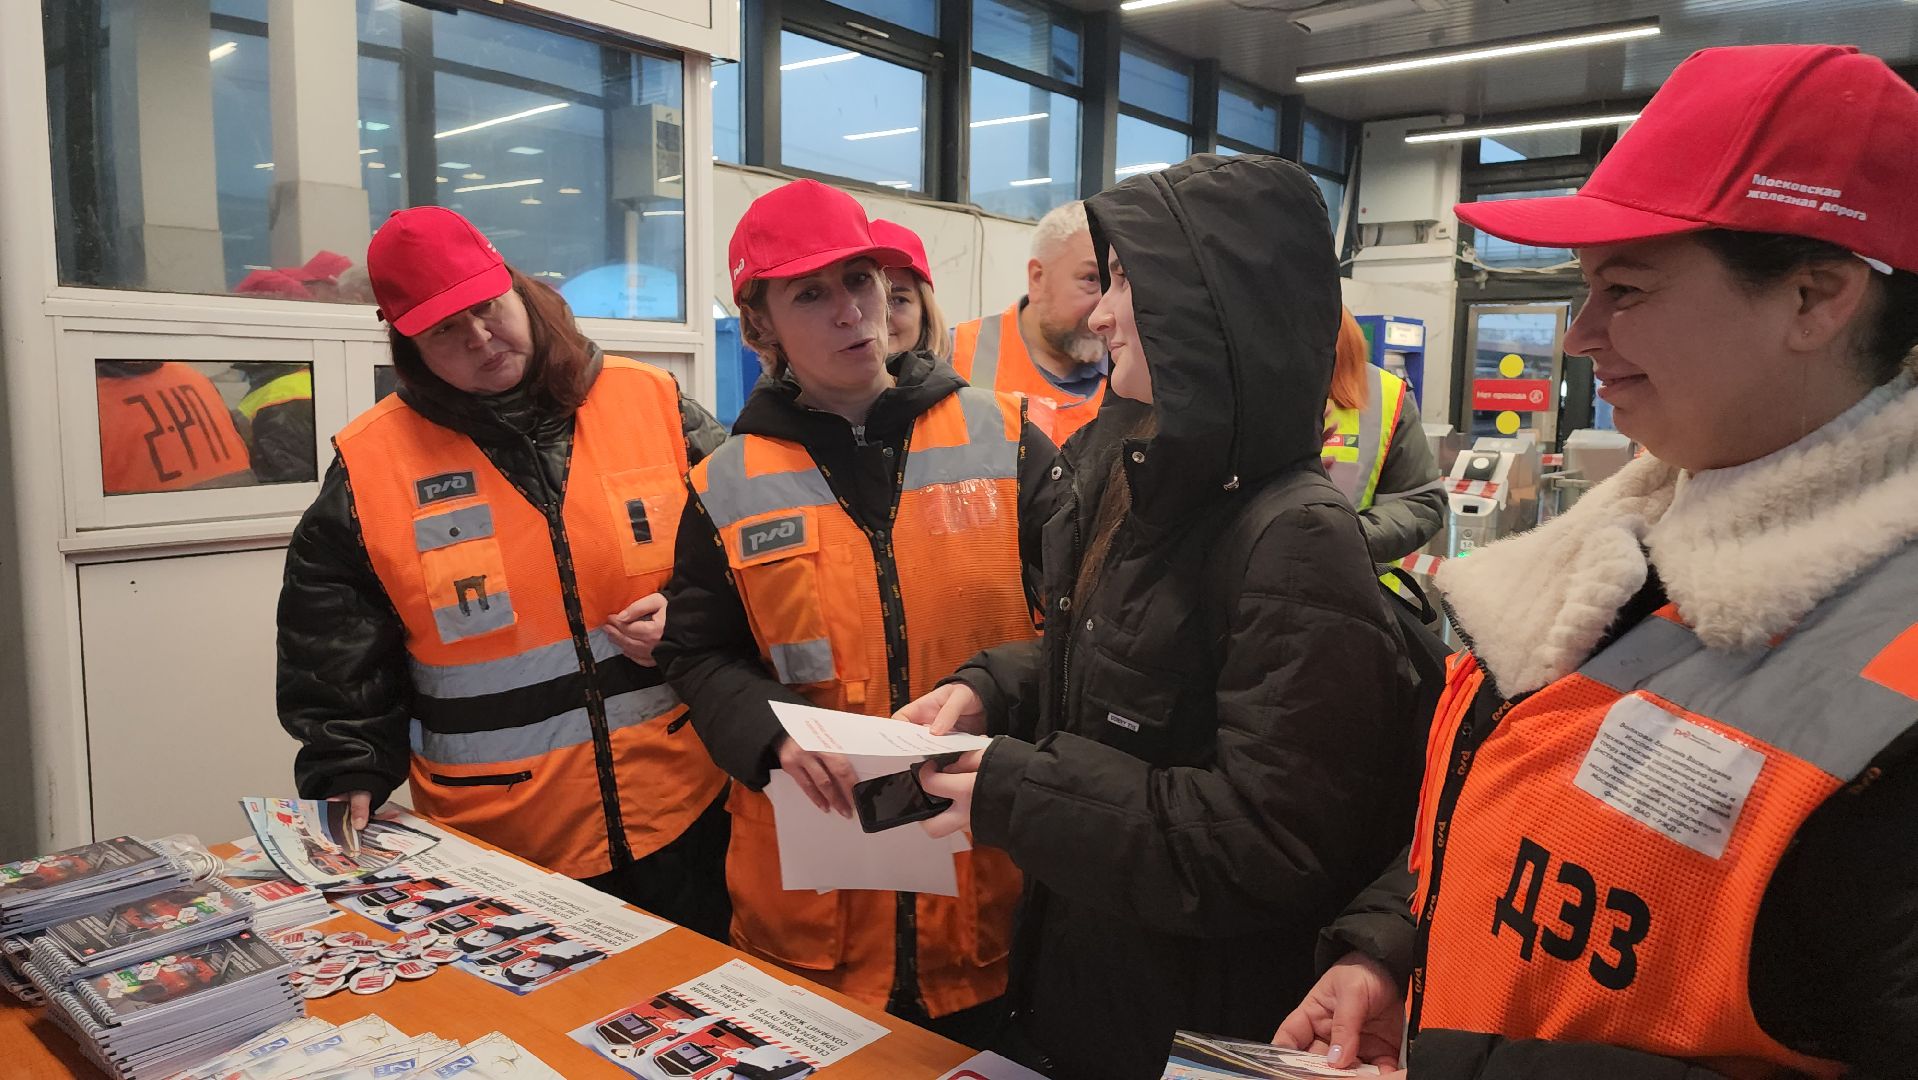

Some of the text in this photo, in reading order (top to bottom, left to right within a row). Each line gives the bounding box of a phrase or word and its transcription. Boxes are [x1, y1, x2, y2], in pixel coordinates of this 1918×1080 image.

[1752, 173, 1841, 198] Московская
[1746, 189, 1867, 221] железная дорога
[1491, 836, 1651, 991] ДЭЗ
[779, 1009, 806, 1026] ЖИЗНЬ
[792, 1036, 830, 1057] СЕКУНДА
[804, 1022, 849, 1047] СОХРАНИТ
